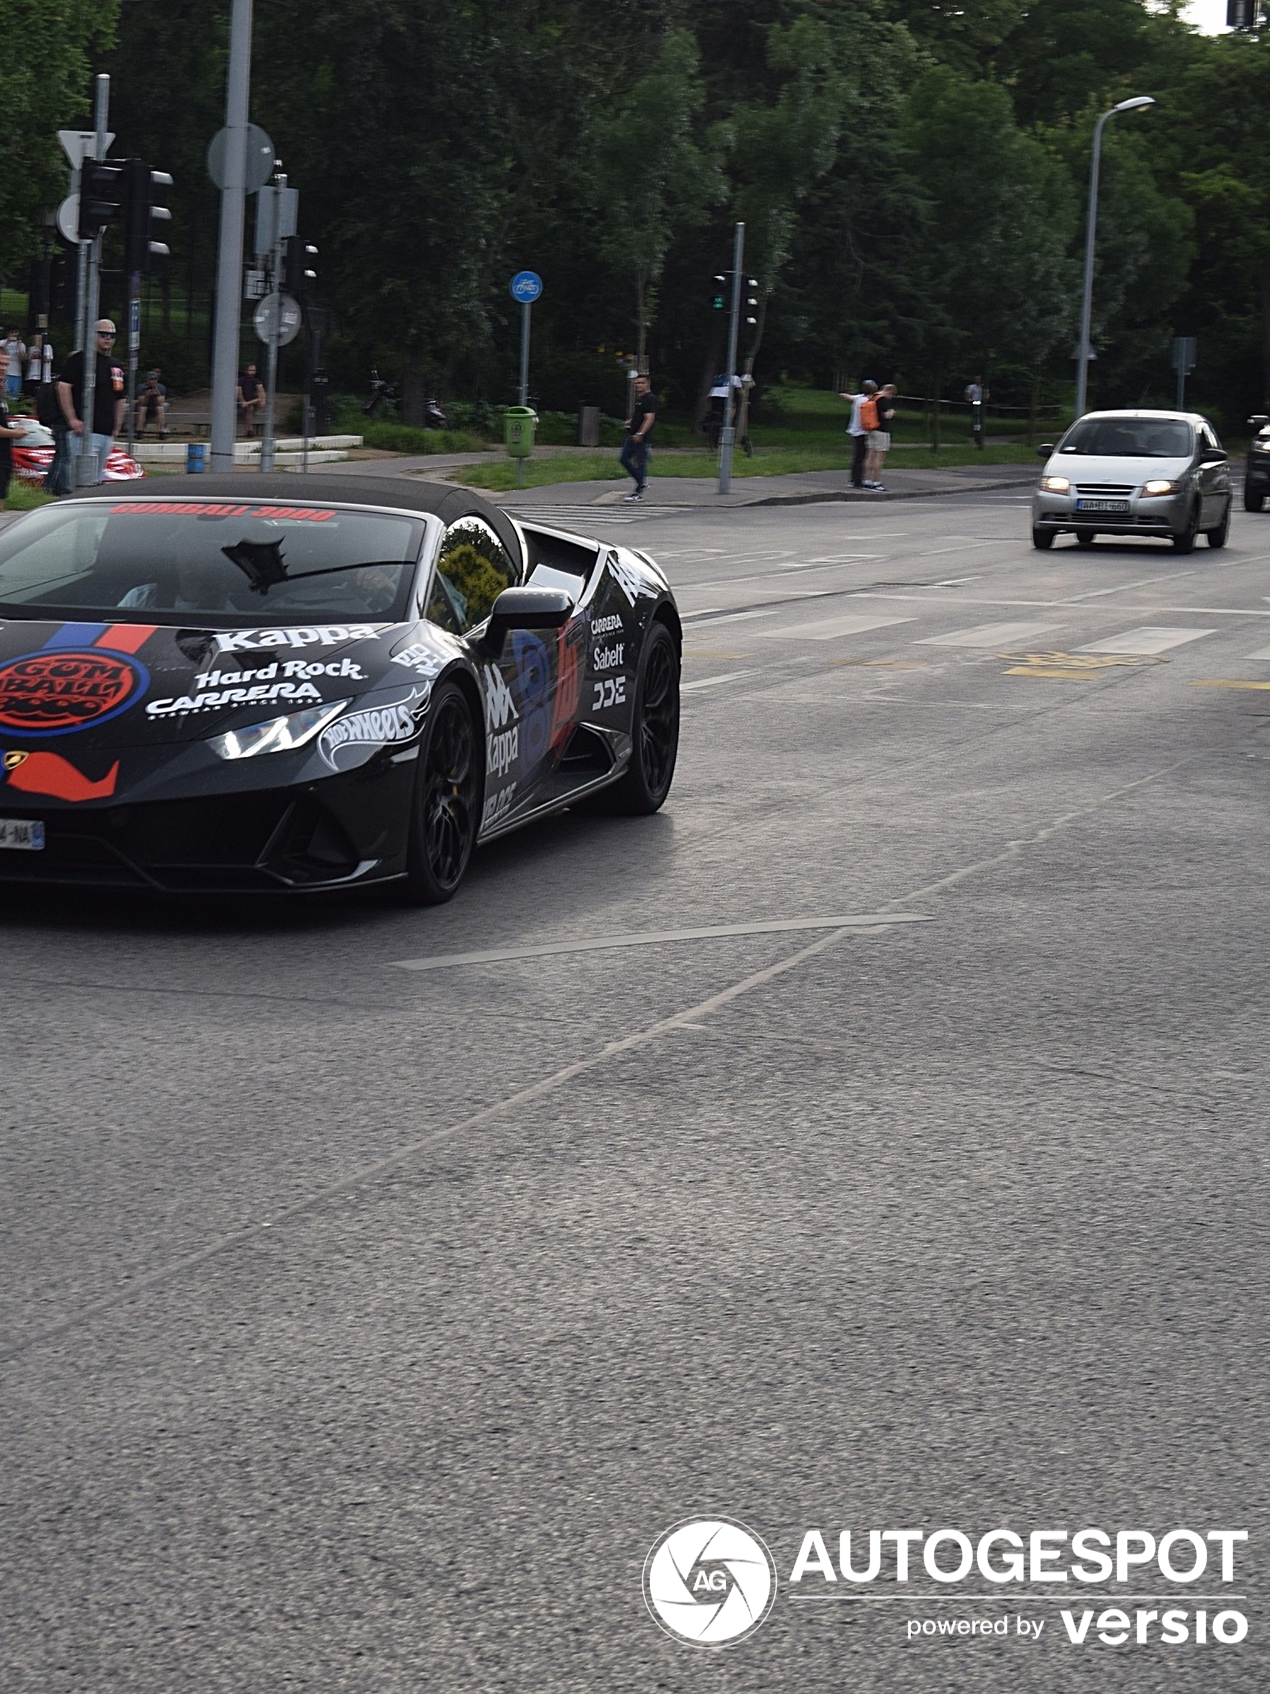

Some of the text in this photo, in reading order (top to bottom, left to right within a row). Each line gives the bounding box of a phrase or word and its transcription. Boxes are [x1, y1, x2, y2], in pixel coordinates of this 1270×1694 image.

[108, 502, 337, 522] GUMBALL 3000
[211, 625, 382, 653] Kappa
[590, 614, 624, 636] CARRERA
[593, 642, 625, 672] Sabelt
[193, 662, 279, 690] Hard
[281, 657, 365, 681] Rock
[144, 682, 322, 715] CARRERA
[486, 725, 519, 778] Kappa
